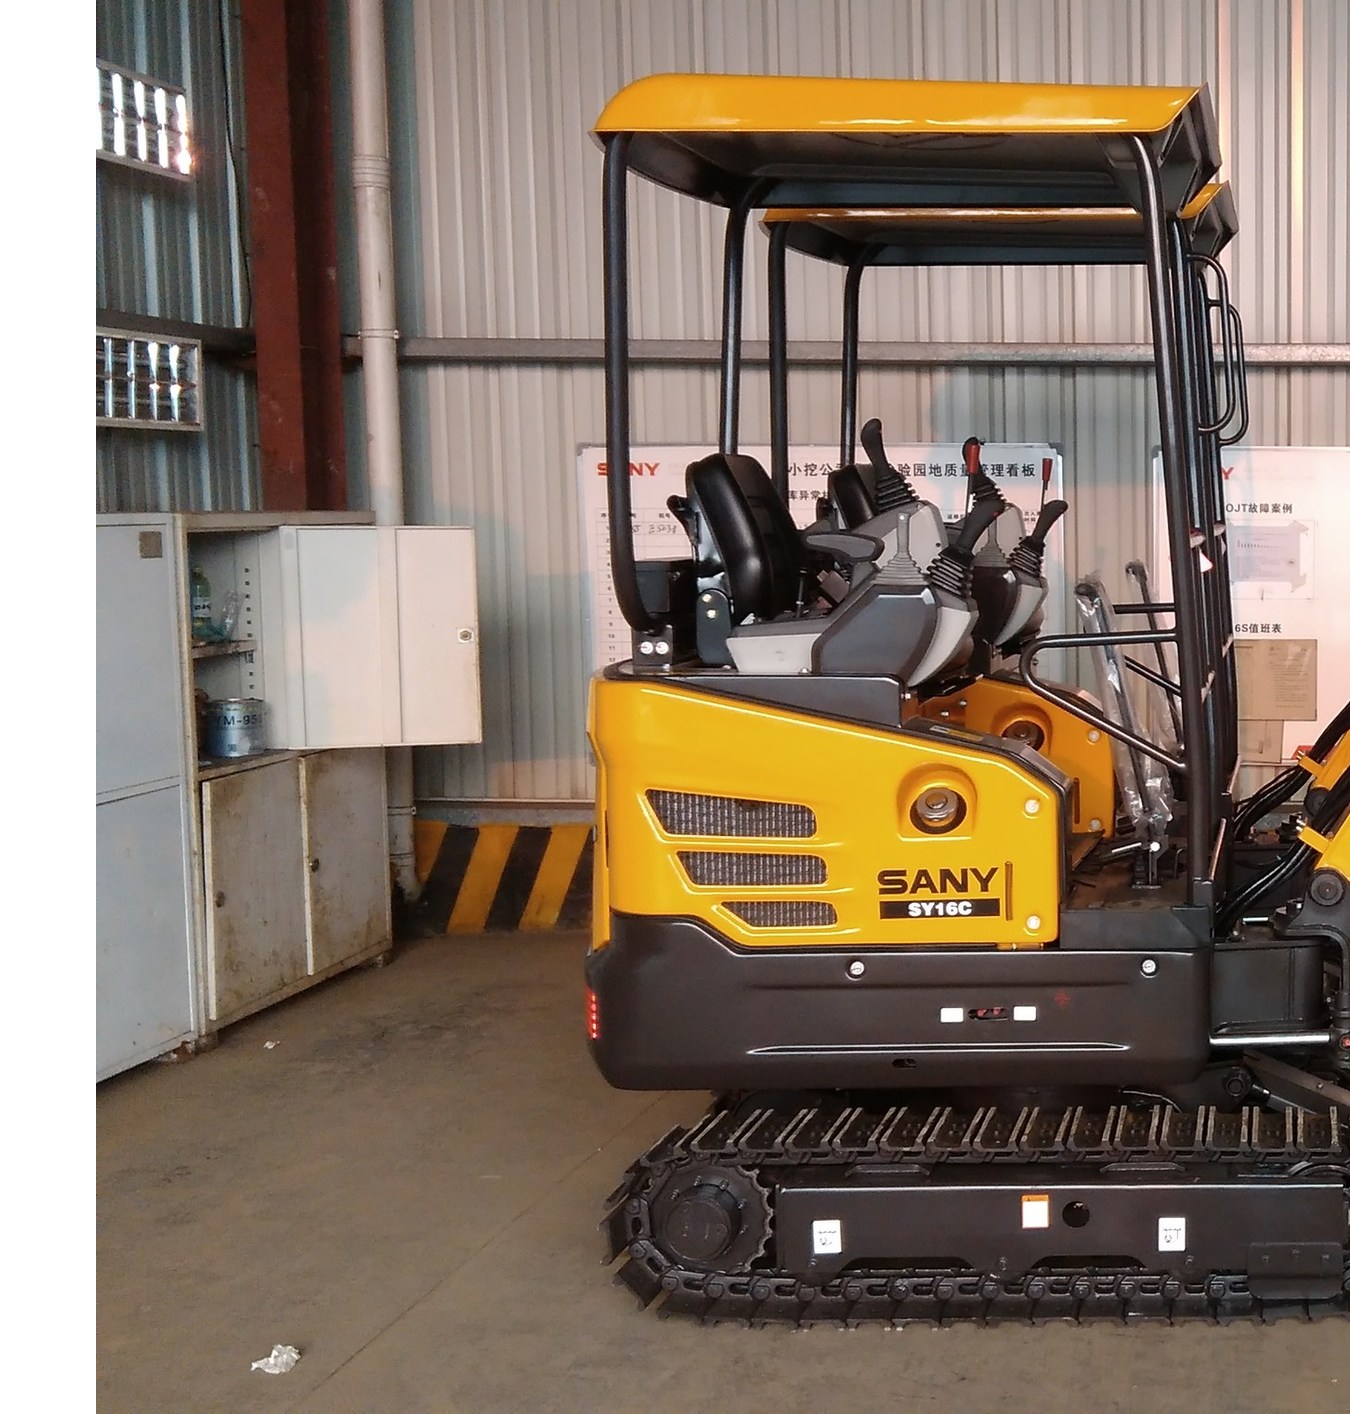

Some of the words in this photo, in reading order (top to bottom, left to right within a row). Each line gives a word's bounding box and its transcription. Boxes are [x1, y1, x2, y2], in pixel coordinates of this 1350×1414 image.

[597, 462, 660, 477] SNY
[877, 867, 998, 895] SANY
[908, 901, 972, 917] SY16C
